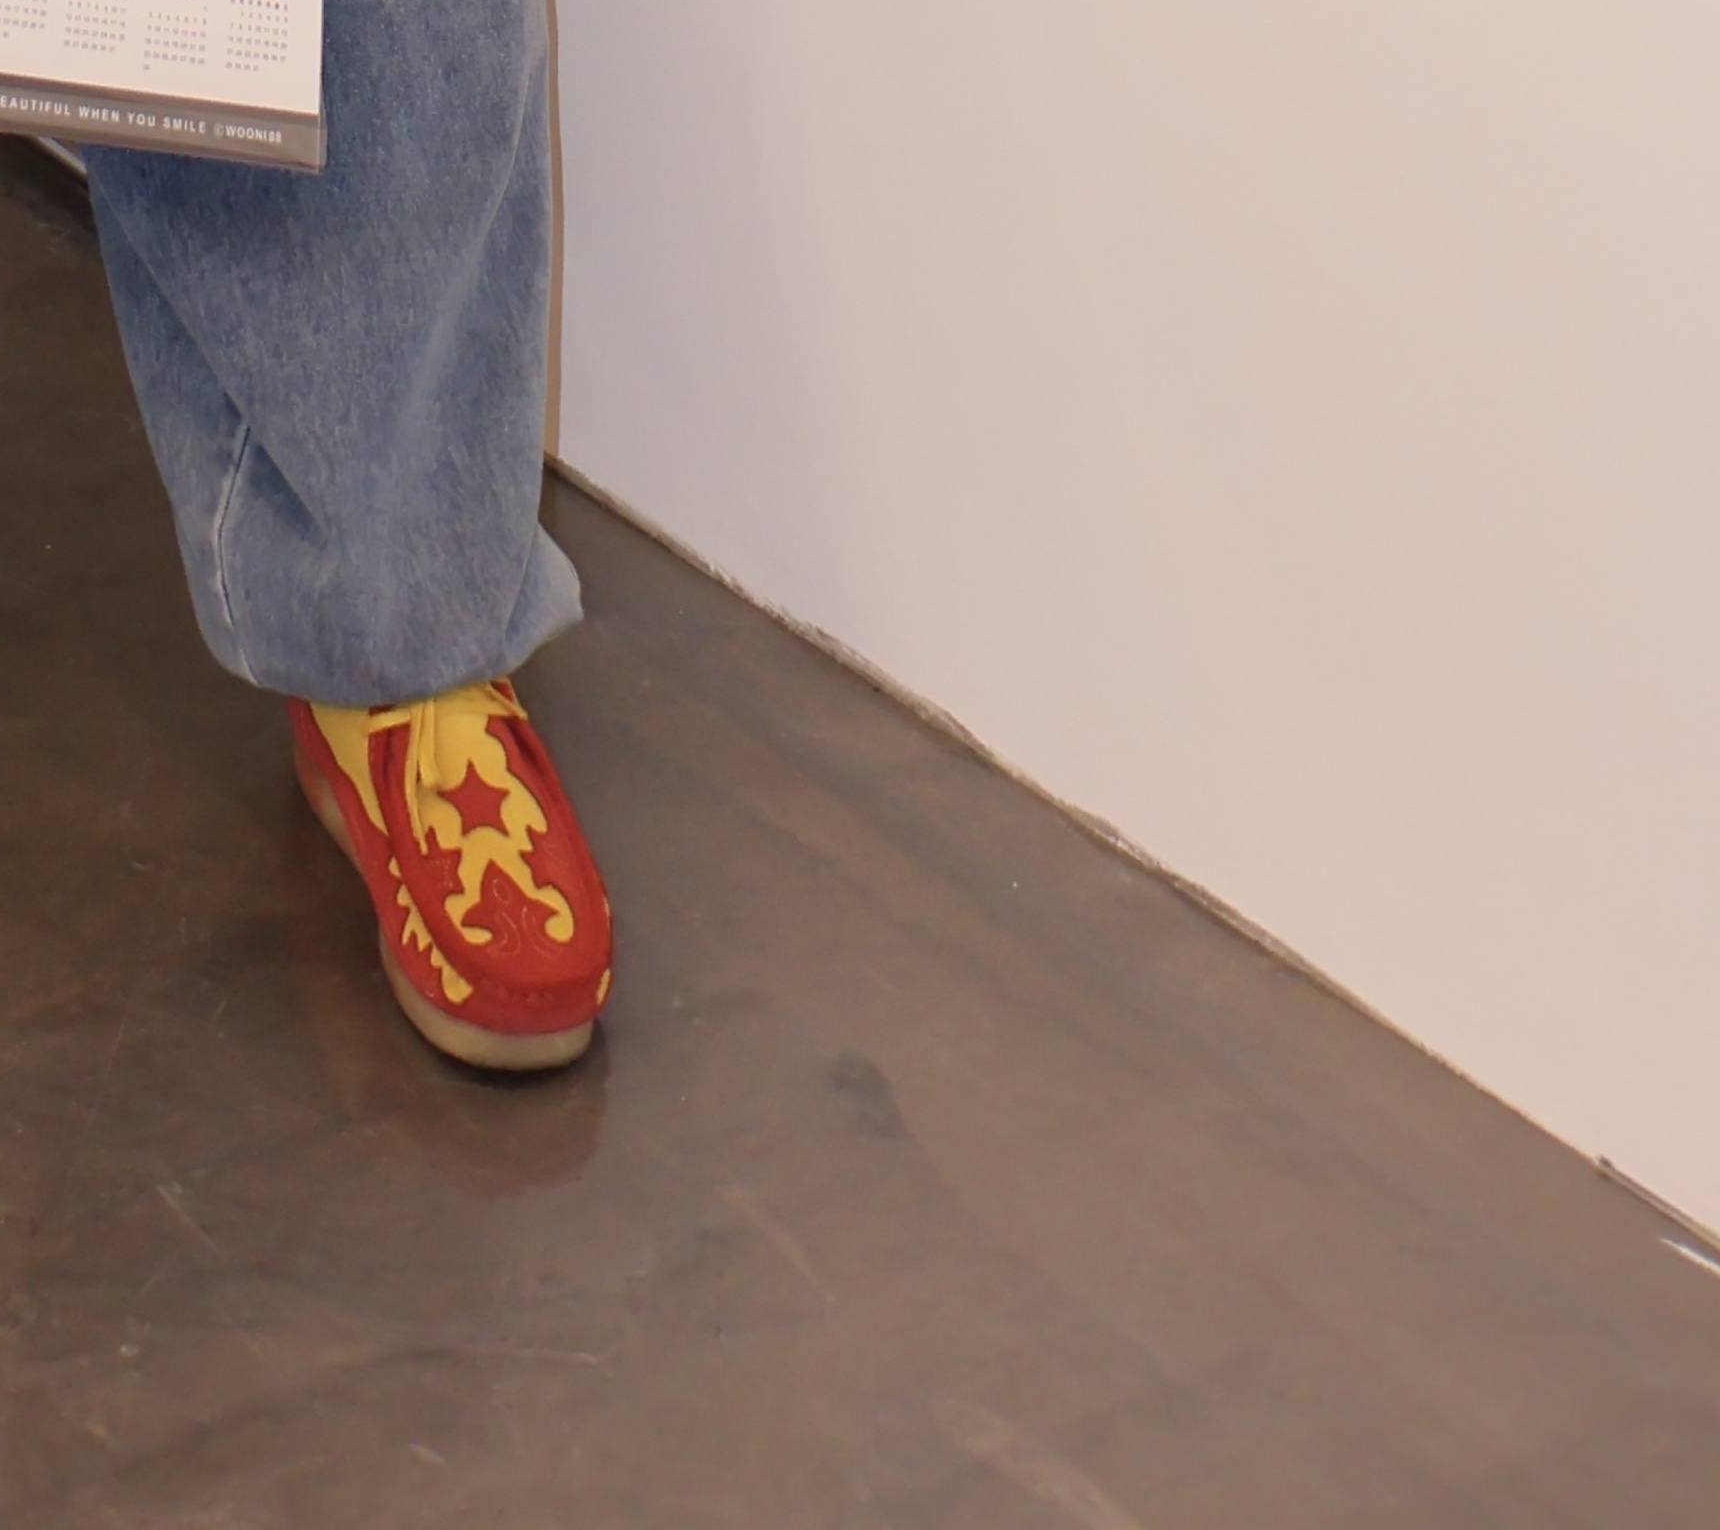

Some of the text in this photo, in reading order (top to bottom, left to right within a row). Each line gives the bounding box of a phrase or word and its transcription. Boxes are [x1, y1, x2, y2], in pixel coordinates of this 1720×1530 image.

[79, 106, 120, 123] WHEN
[127, 112, 157, 128] YOU
[162, 116, 207, 134] SMILE
